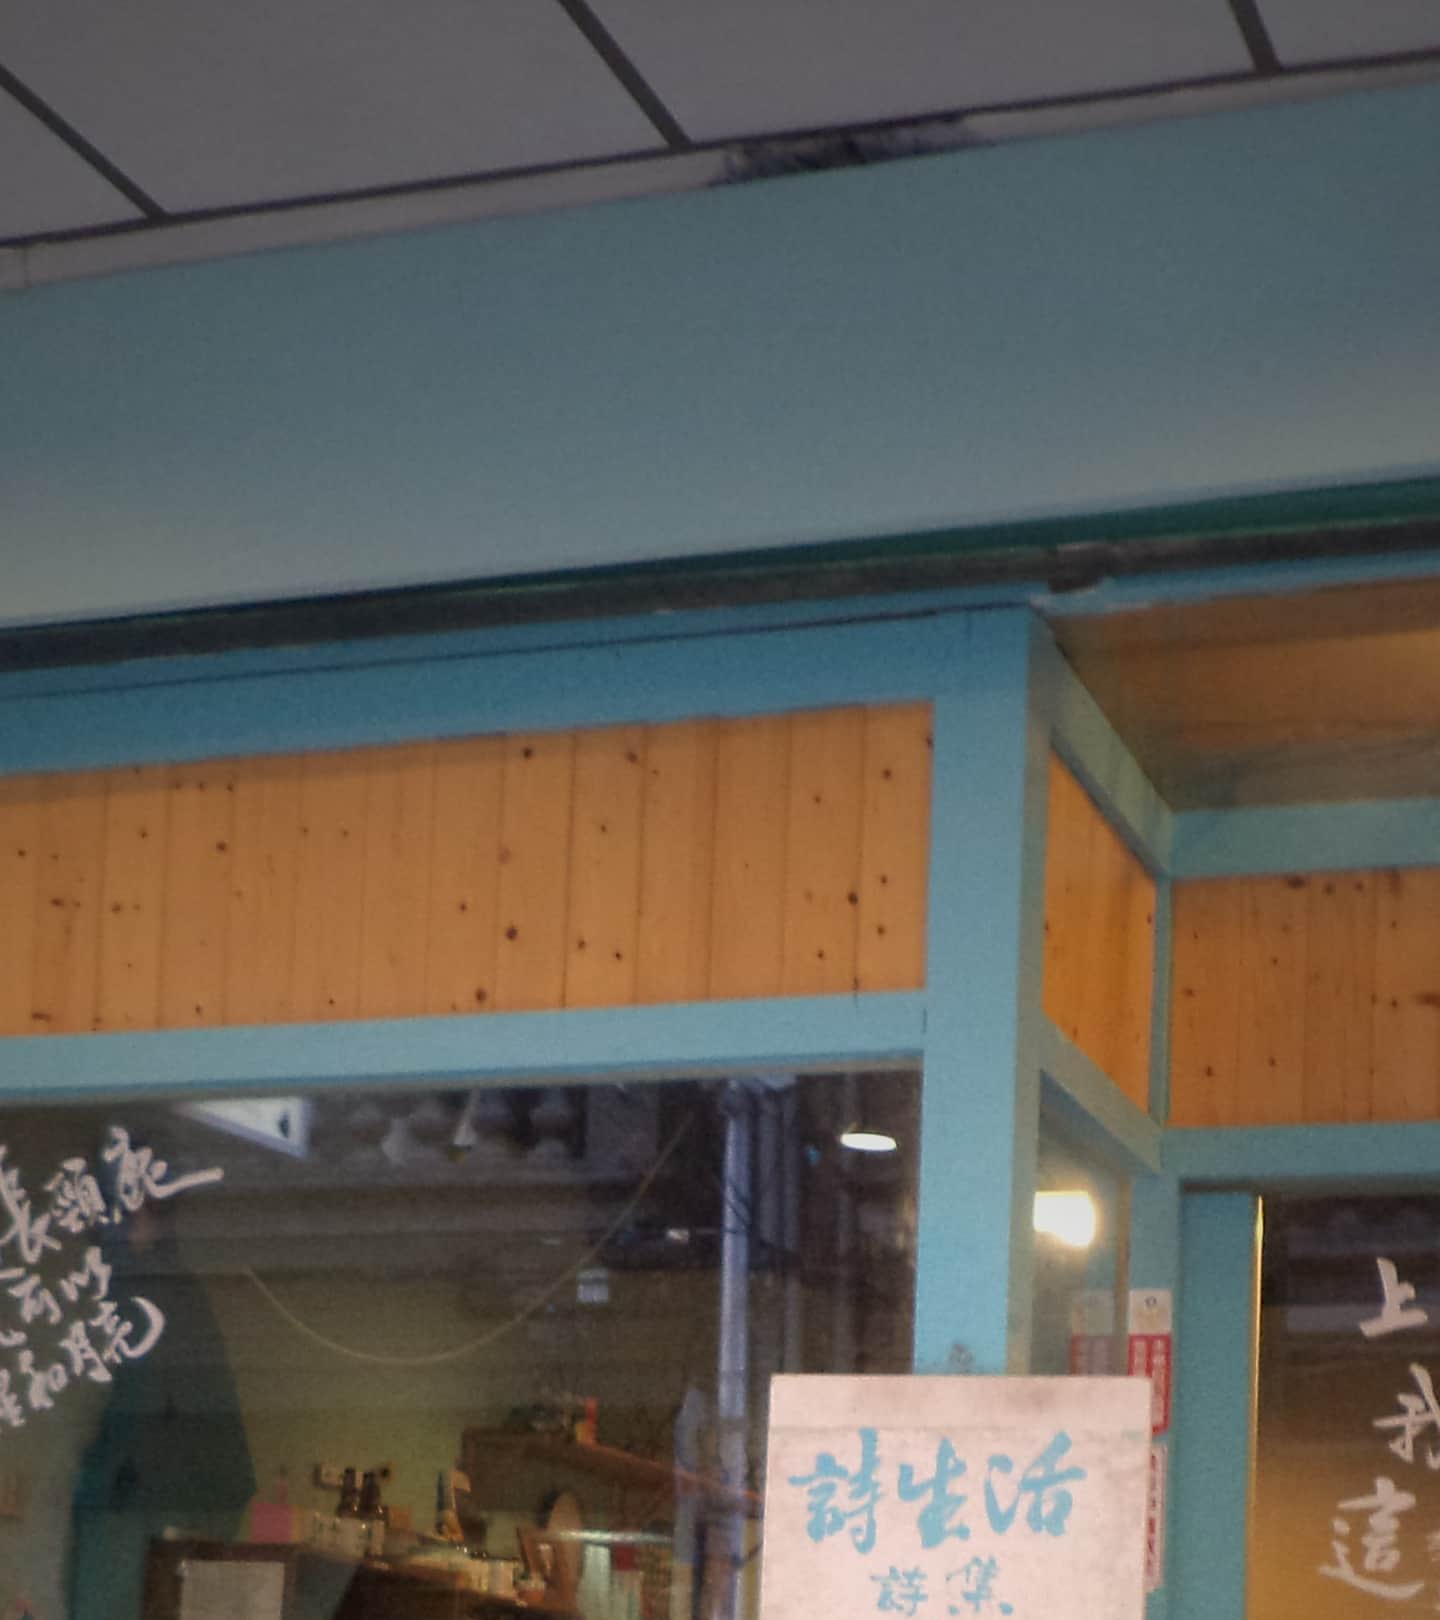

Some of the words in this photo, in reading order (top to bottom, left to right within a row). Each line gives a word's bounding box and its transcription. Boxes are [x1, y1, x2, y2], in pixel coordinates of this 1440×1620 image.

[787, 1426, 1088, 1556] 詩生活
[869, 1555, 1015, 1618] 詩集
